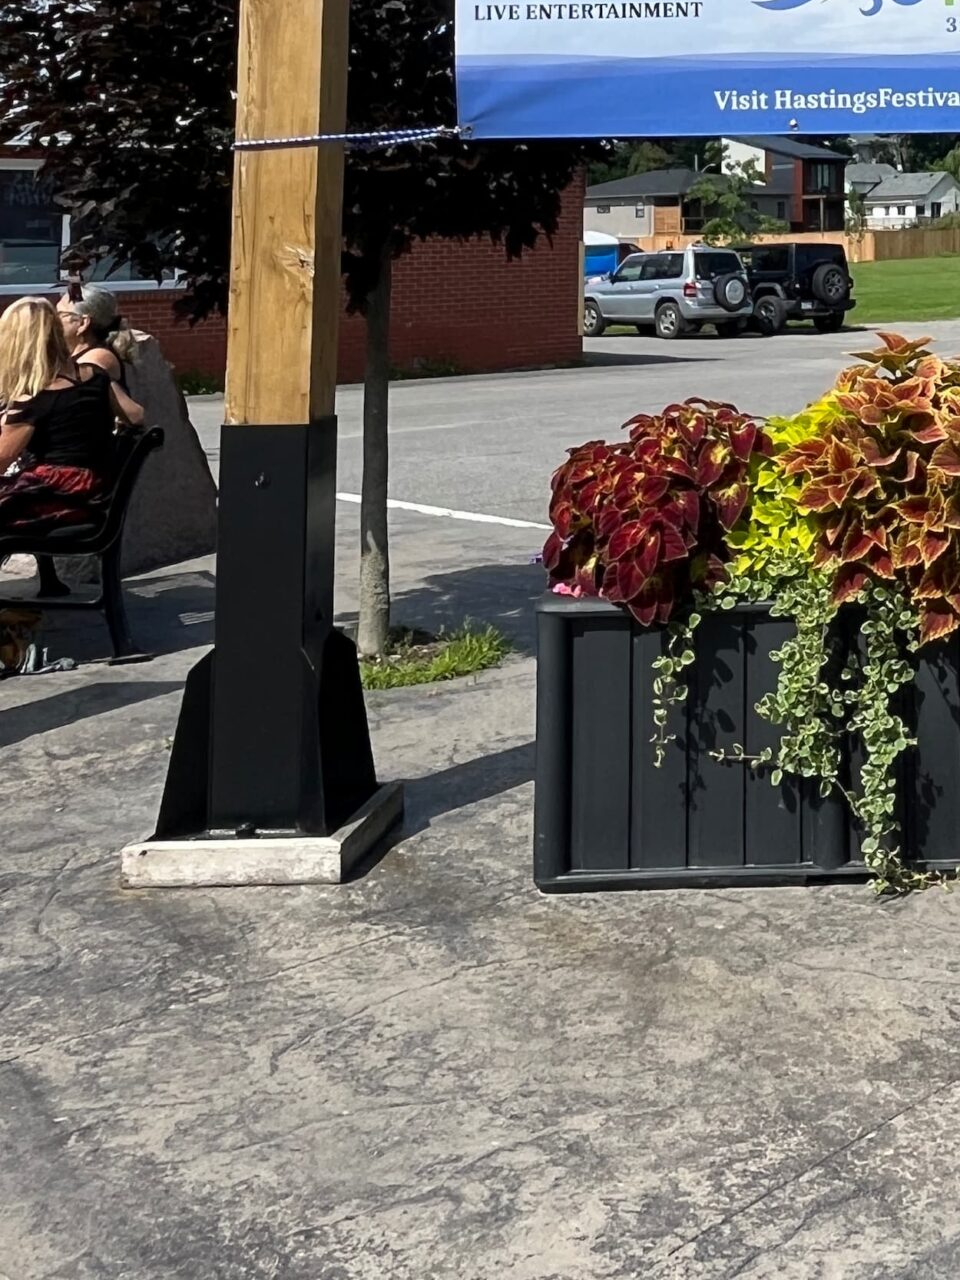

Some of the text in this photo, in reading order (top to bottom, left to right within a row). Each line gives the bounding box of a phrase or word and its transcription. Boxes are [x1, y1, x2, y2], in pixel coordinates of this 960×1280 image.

[474, 2, 704, 21] LIVE ENTERTAINMENT
[714, 90, 768, 110] Visit
